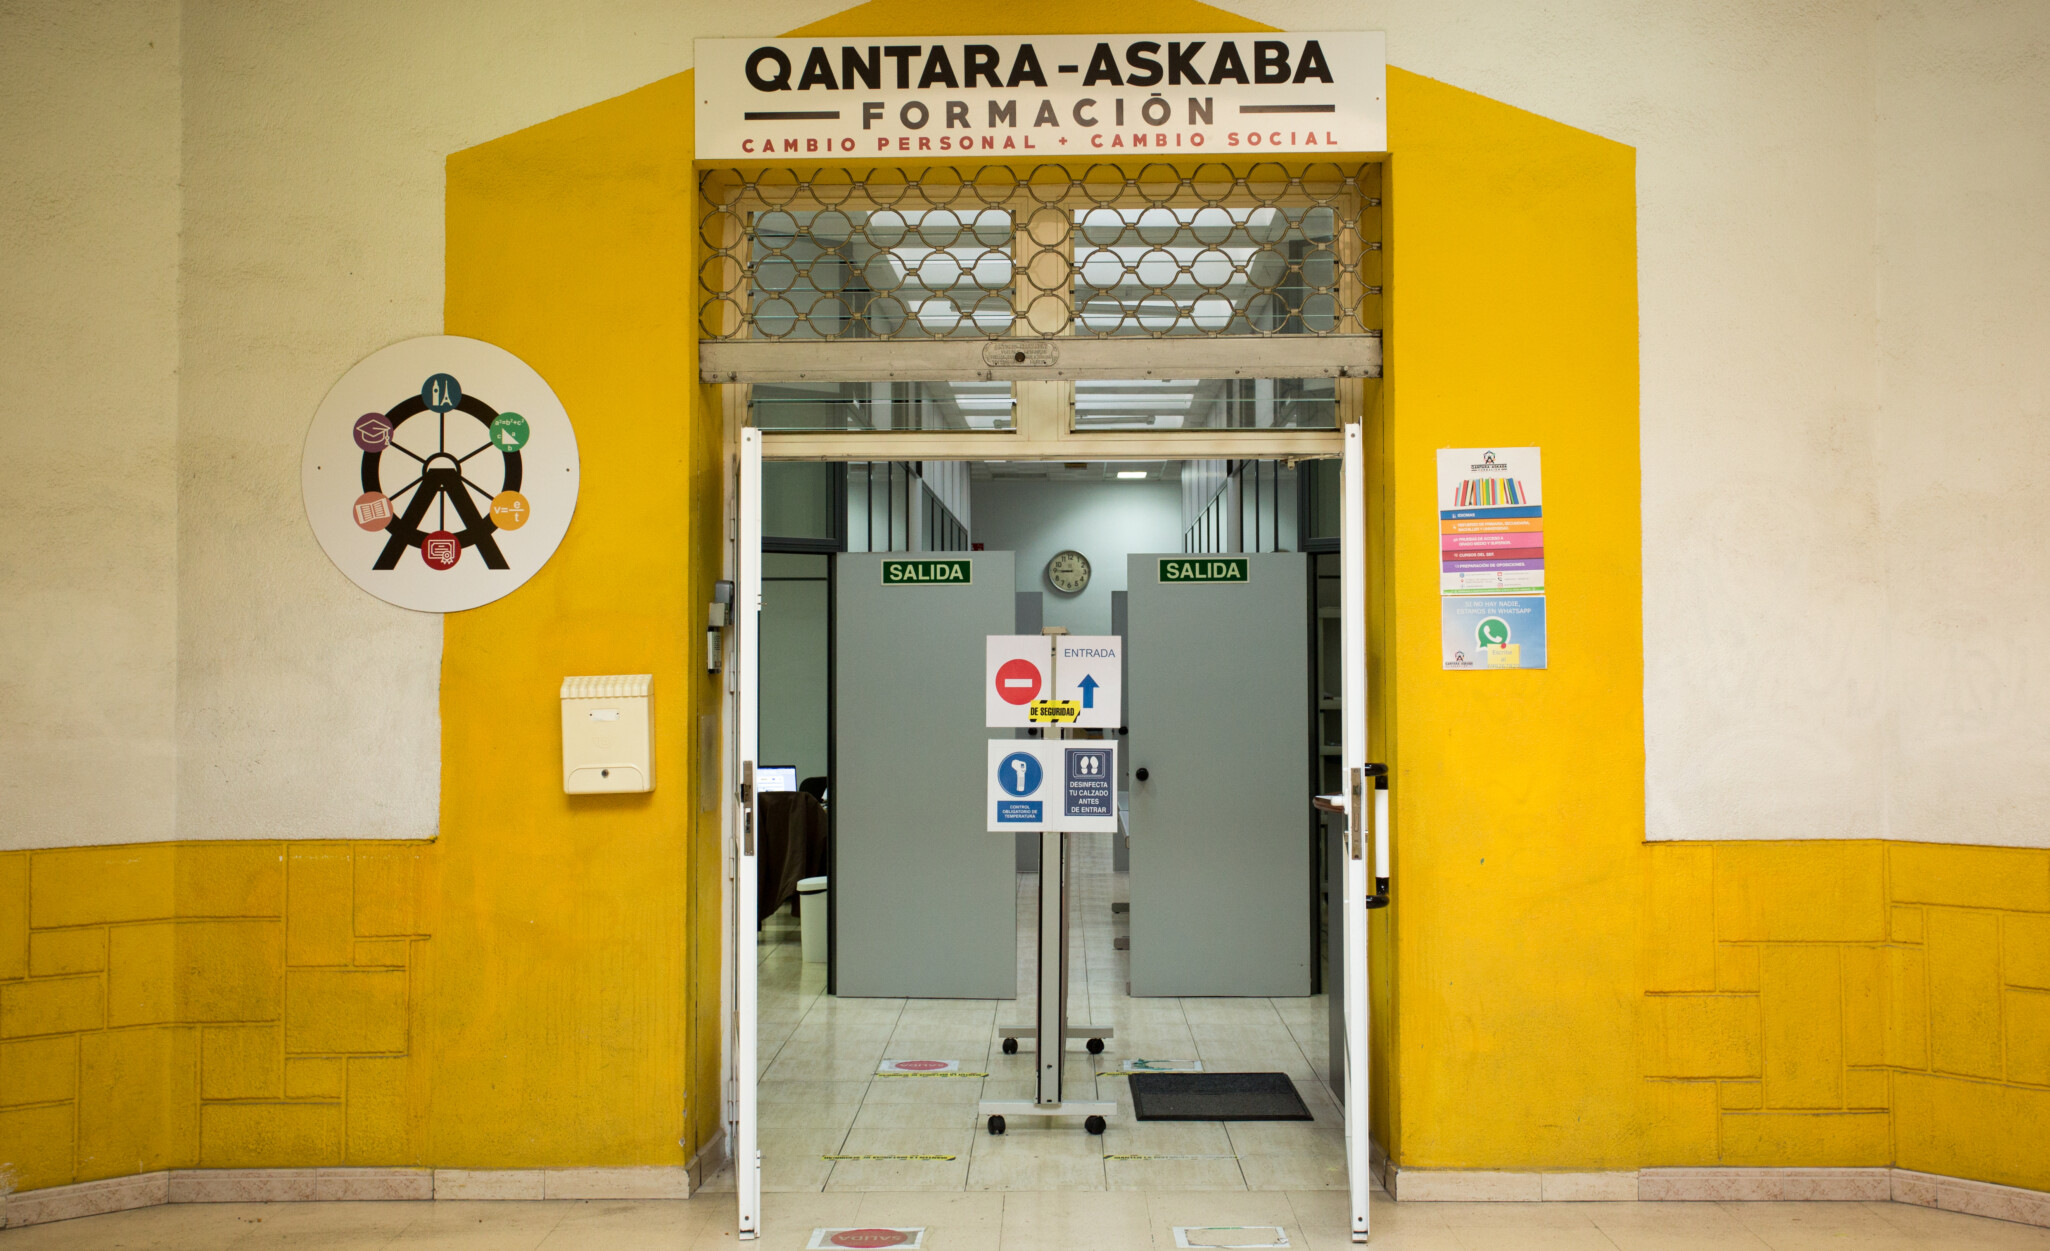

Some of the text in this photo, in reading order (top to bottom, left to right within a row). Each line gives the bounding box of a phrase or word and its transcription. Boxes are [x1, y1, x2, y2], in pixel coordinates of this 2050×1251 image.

[745, 44, 1047, 92] QANTARA
[742, 138, 856, 153] CAMBIO
[877, 136, 1037, 152] PERSONAL
[1091, 133, 1205, 149] CAMBIO
[1227, 132, 1338, 147] SOCIAL
[889, 564, 964, 581] SALIDA
[1166, 562, 1241, 579] SALIDA
[1064, 648, 1116, 658] ENTRADA
[1030, 707, 1075, 716] DE SEGURIDAD
